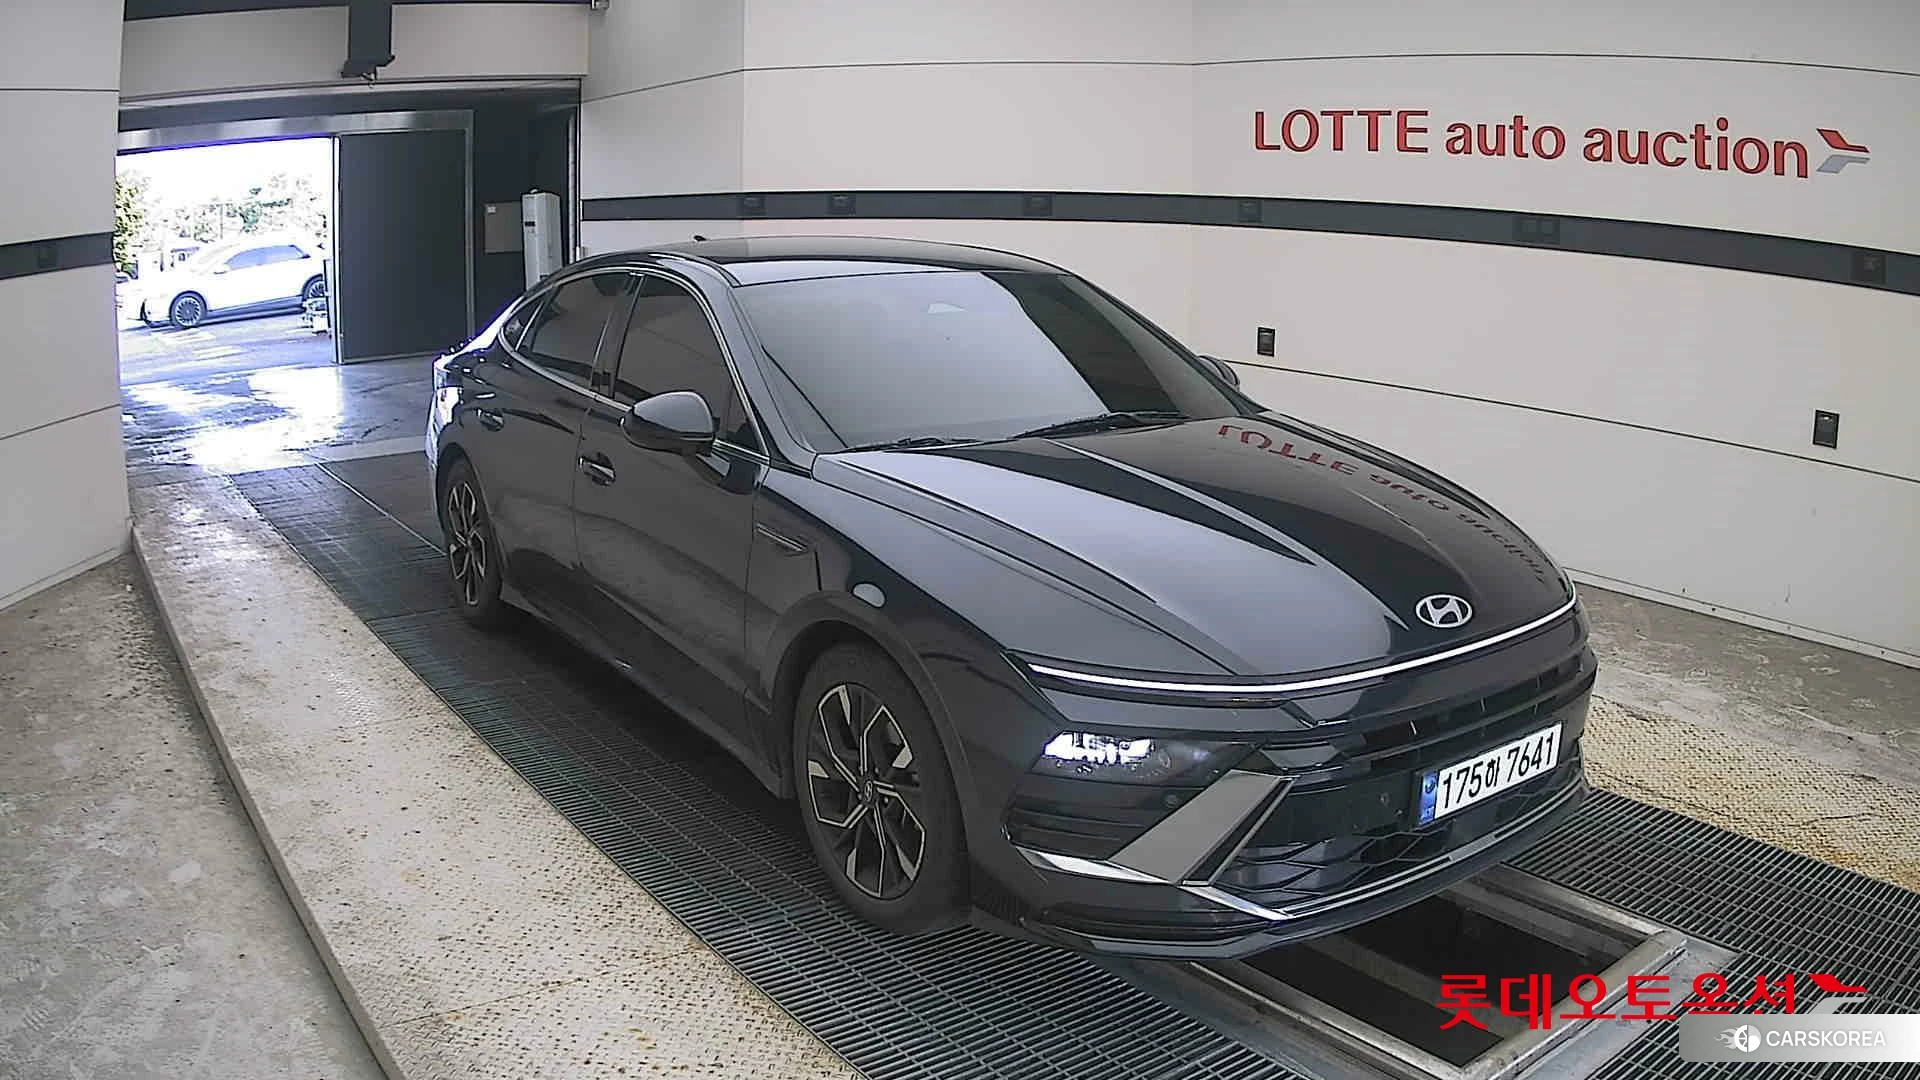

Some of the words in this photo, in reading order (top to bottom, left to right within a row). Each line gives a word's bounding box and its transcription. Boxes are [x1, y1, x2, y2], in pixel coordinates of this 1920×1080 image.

[1254, 109, 1430, 153] LOTTE
[1445, 114, 1567, 161] auto
[1582, 117, 1810, 179] auction
[1442, 756, 1501, 809] 175하
[1506, 732, 1555, 782] 7641
